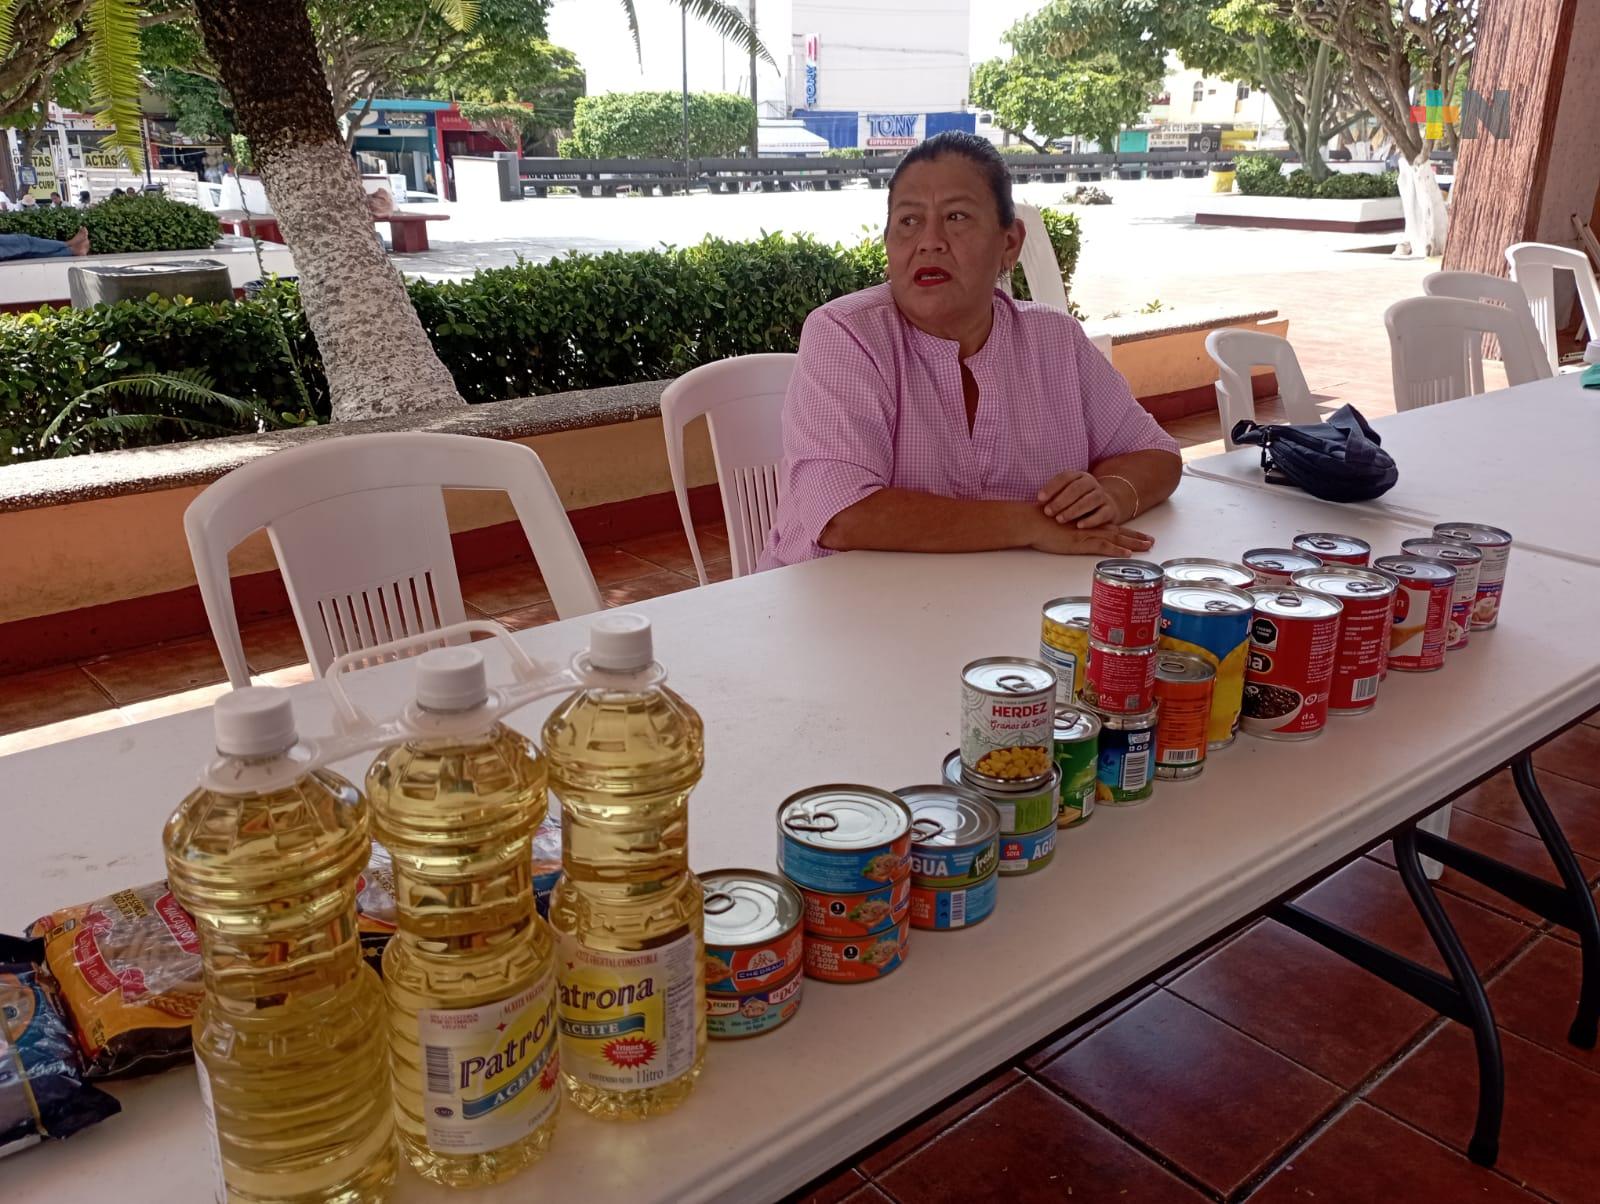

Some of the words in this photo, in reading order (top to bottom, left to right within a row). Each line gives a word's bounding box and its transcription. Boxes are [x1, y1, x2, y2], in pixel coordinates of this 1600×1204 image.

[806, 64, 817, 107] TONY
[867, 114, 918, 138] TONY
[32, 156, 52, 168] TAS
[85, 154, 118, 167] ACTAS
[38, 180, 55, 190] CURP
[992, 702, 1047, 719] HERDEZ
[991, 720, 1020, 731] Granos
[1020, 721, 1031, 730] de
[1032, 830, 1056, 860] AGU
[911, 856, 949, 877] GUA
[564, 1023, 620, 1036] ACEITE
[641, 1067, 664, 1083] litro
